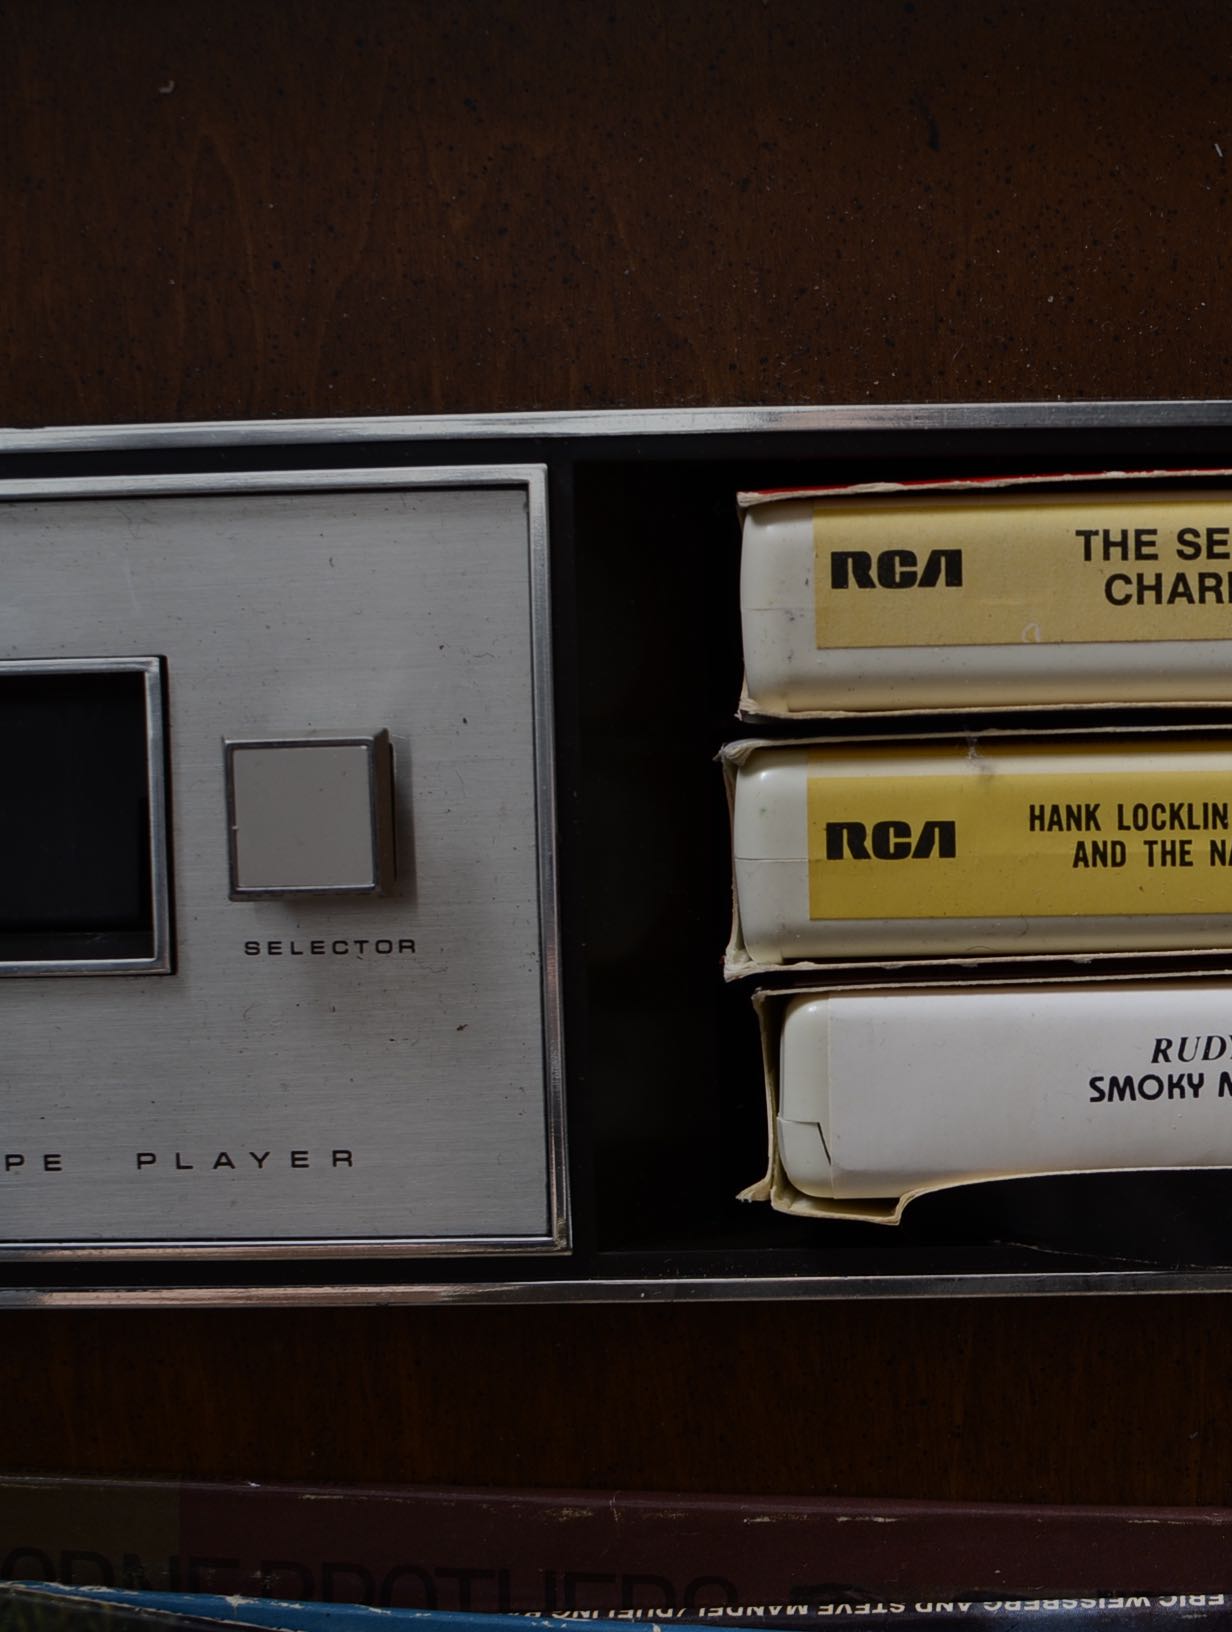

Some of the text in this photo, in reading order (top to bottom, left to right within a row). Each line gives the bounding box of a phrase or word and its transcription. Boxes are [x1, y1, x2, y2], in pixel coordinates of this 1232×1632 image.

[1076, 529, 1158, 561] THE
[831, 549, 962, 589] RCA
[1030, 804, 1101, 831] HANK
[1118, 803, 1228, 831] LOCKLIN
[825, 821, 956, 860] RCA
[1073, 840, 1126, 868] AND
[1144, 840, 1193, 867] THE
[245, 939, 415, 955] SELECTOR
[1089, 1073, 1204, 1102] SMOKY
[137, 1150, 352, 1169] PLAYER
